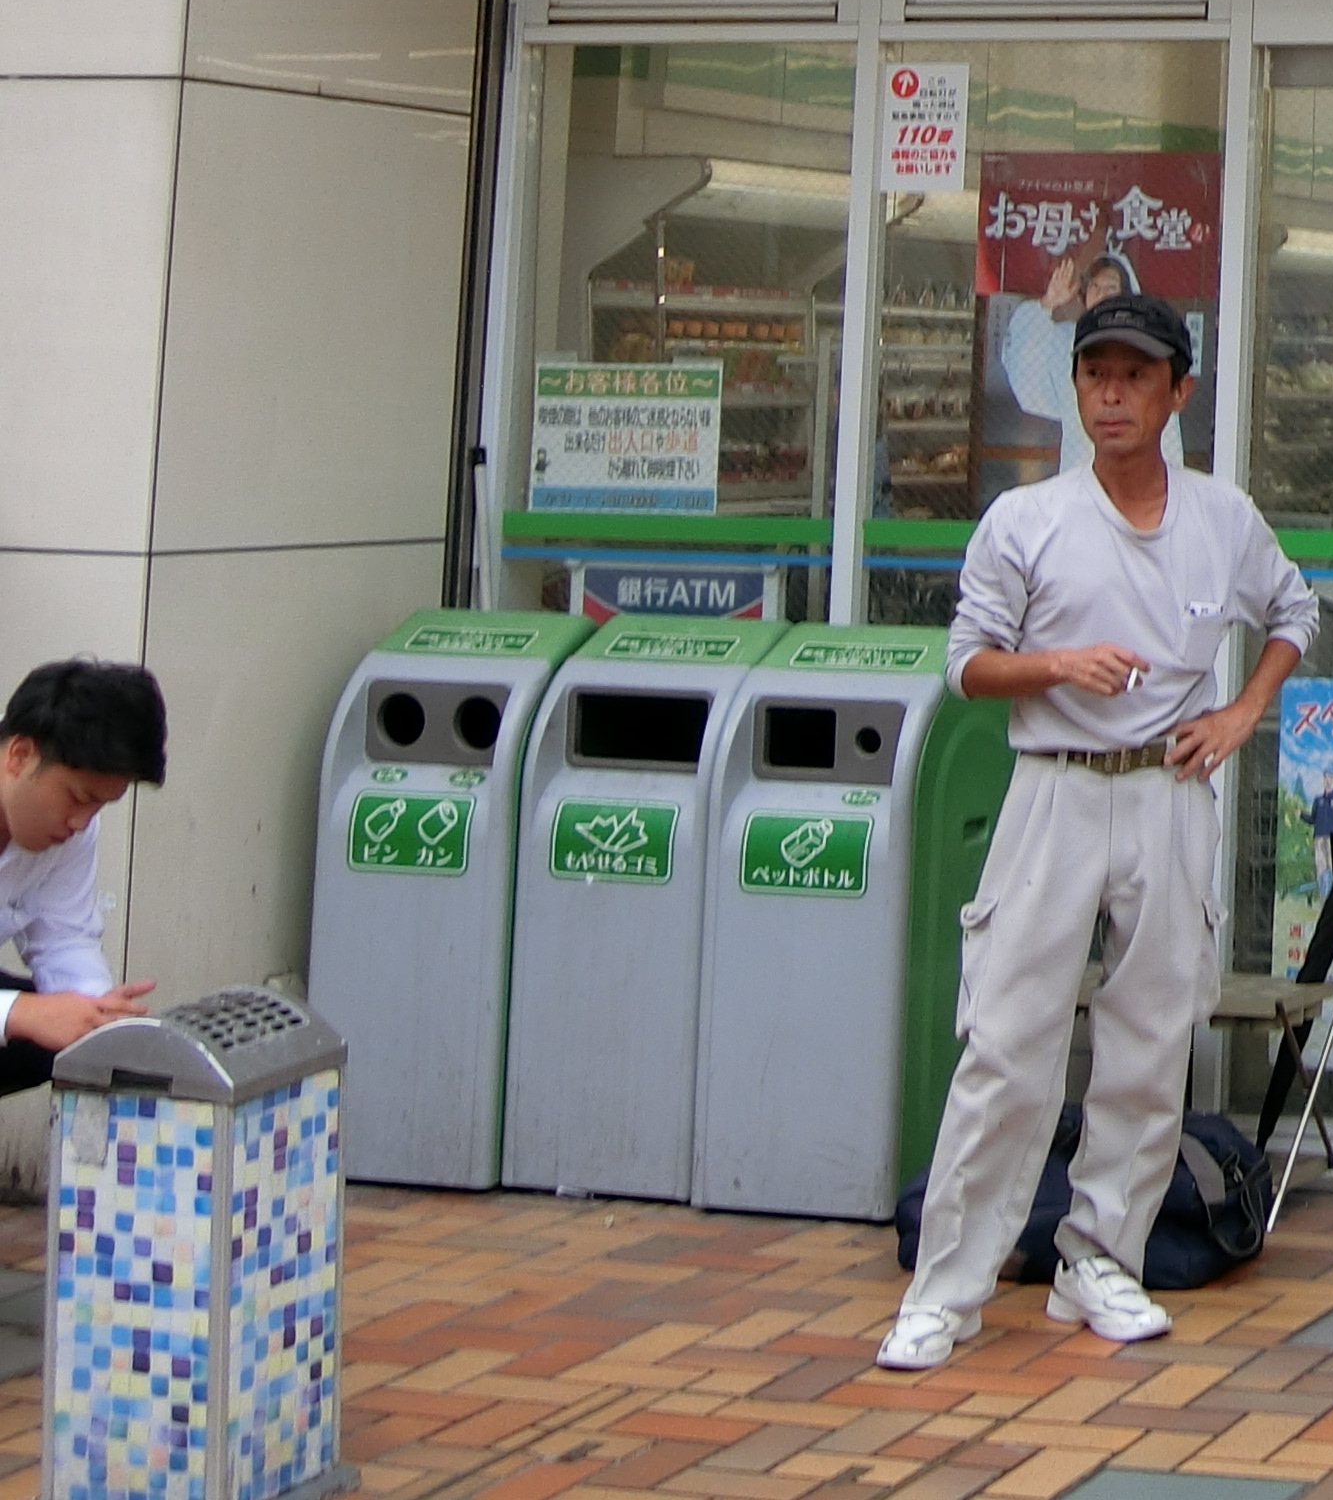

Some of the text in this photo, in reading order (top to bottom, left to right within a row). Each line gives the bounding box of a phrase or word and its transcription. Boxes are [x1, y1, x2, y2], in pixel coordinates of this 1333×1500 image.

[898, 125, 954, 145] 110番
[617, 576, 736, 609] 銀行ATM
[363, 843, 400, 864] ビン
[416, 845, 453, 867] カン
[564, 851, 658, 876] もやせるゴミ
[752, 865, 856, 889] ペットボトル
